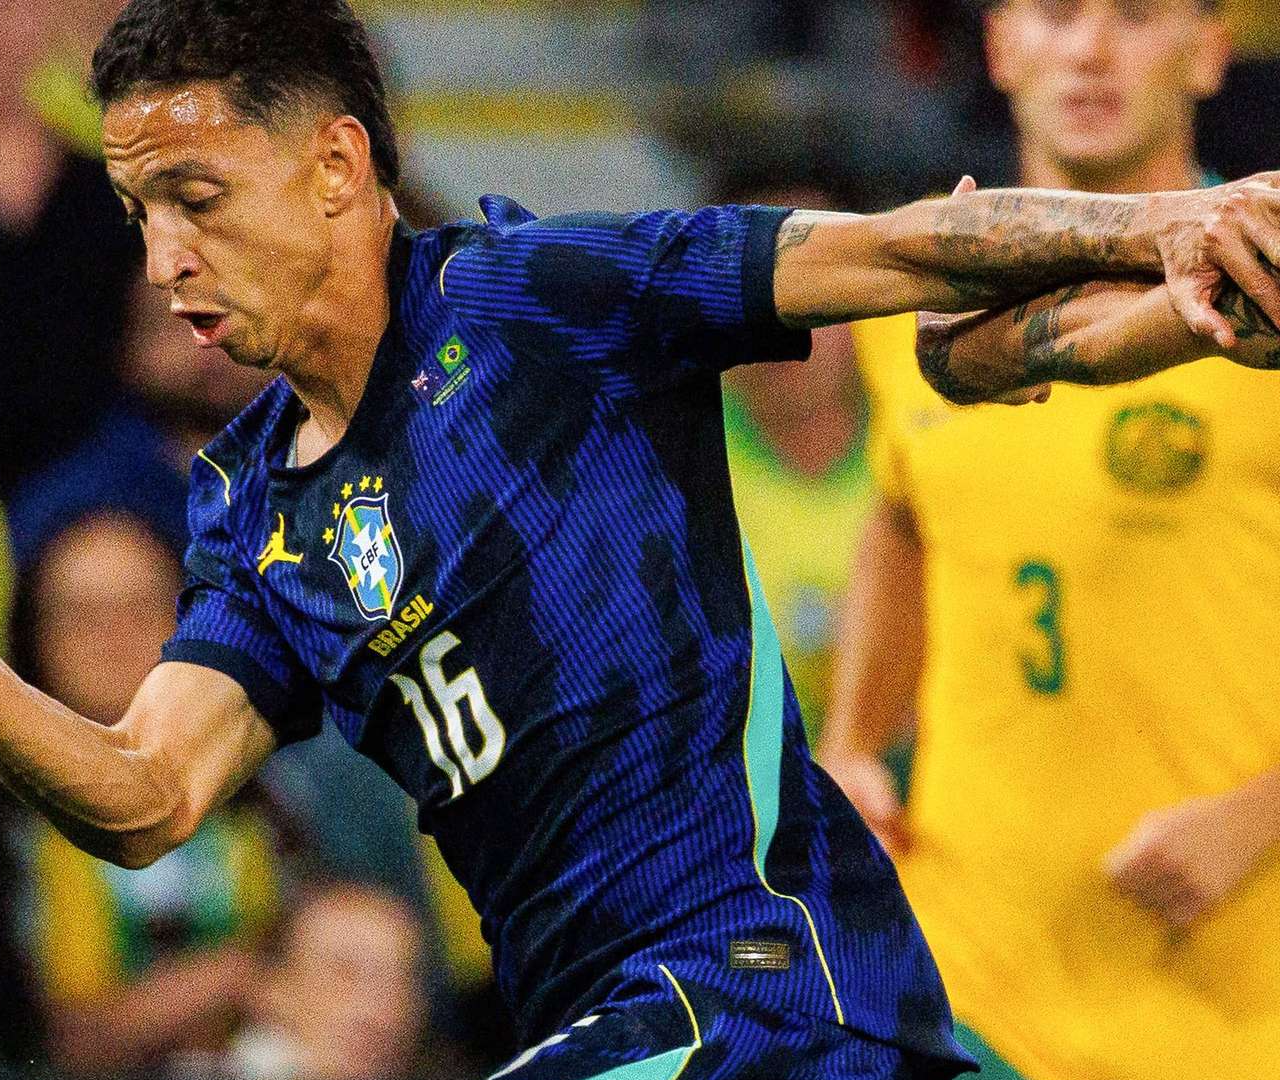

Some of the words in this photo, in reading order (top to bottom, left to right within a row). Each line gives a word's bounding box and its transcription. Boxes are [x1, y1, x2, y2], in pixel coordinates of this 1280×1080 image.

[360, 542, 379, 571] CBF
[368, 594, 434, 657] BRASIL
[1014, 558, 1067, 695] 3
[389, 630, 507, 801] 16
